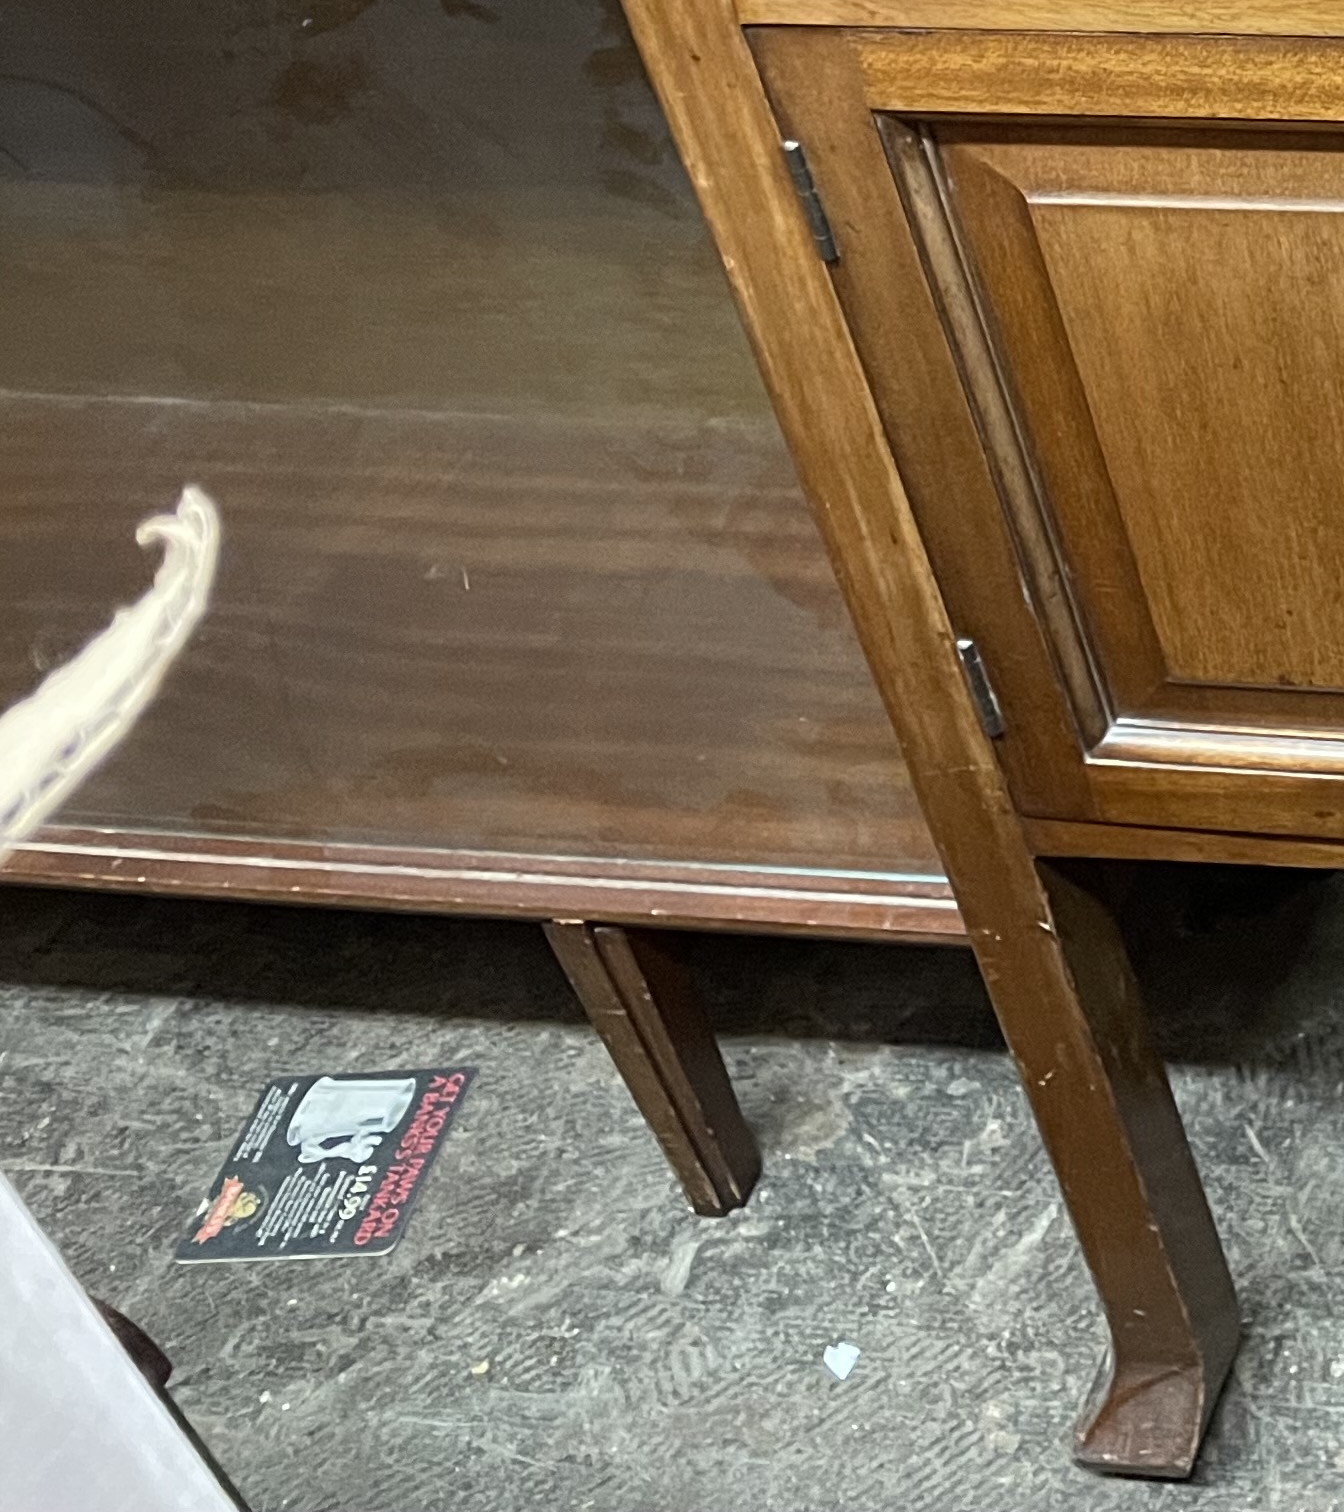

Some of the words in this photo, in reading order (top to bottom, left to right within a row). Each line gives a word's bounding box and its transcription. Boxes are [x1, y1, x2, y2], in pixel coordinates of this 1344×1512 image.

[428, 1075, 447, 1087] A
[439, 1073, 466, 1101] GET
[413, 1107, 448, 1153] YOUR
[338, 1164, 378, 1220] £14.99
[353, 1162, 406, 1245] TANKARD
[389, 1158, 426, 1204] PAWS
[372, 1208, 400, 1237] ON
